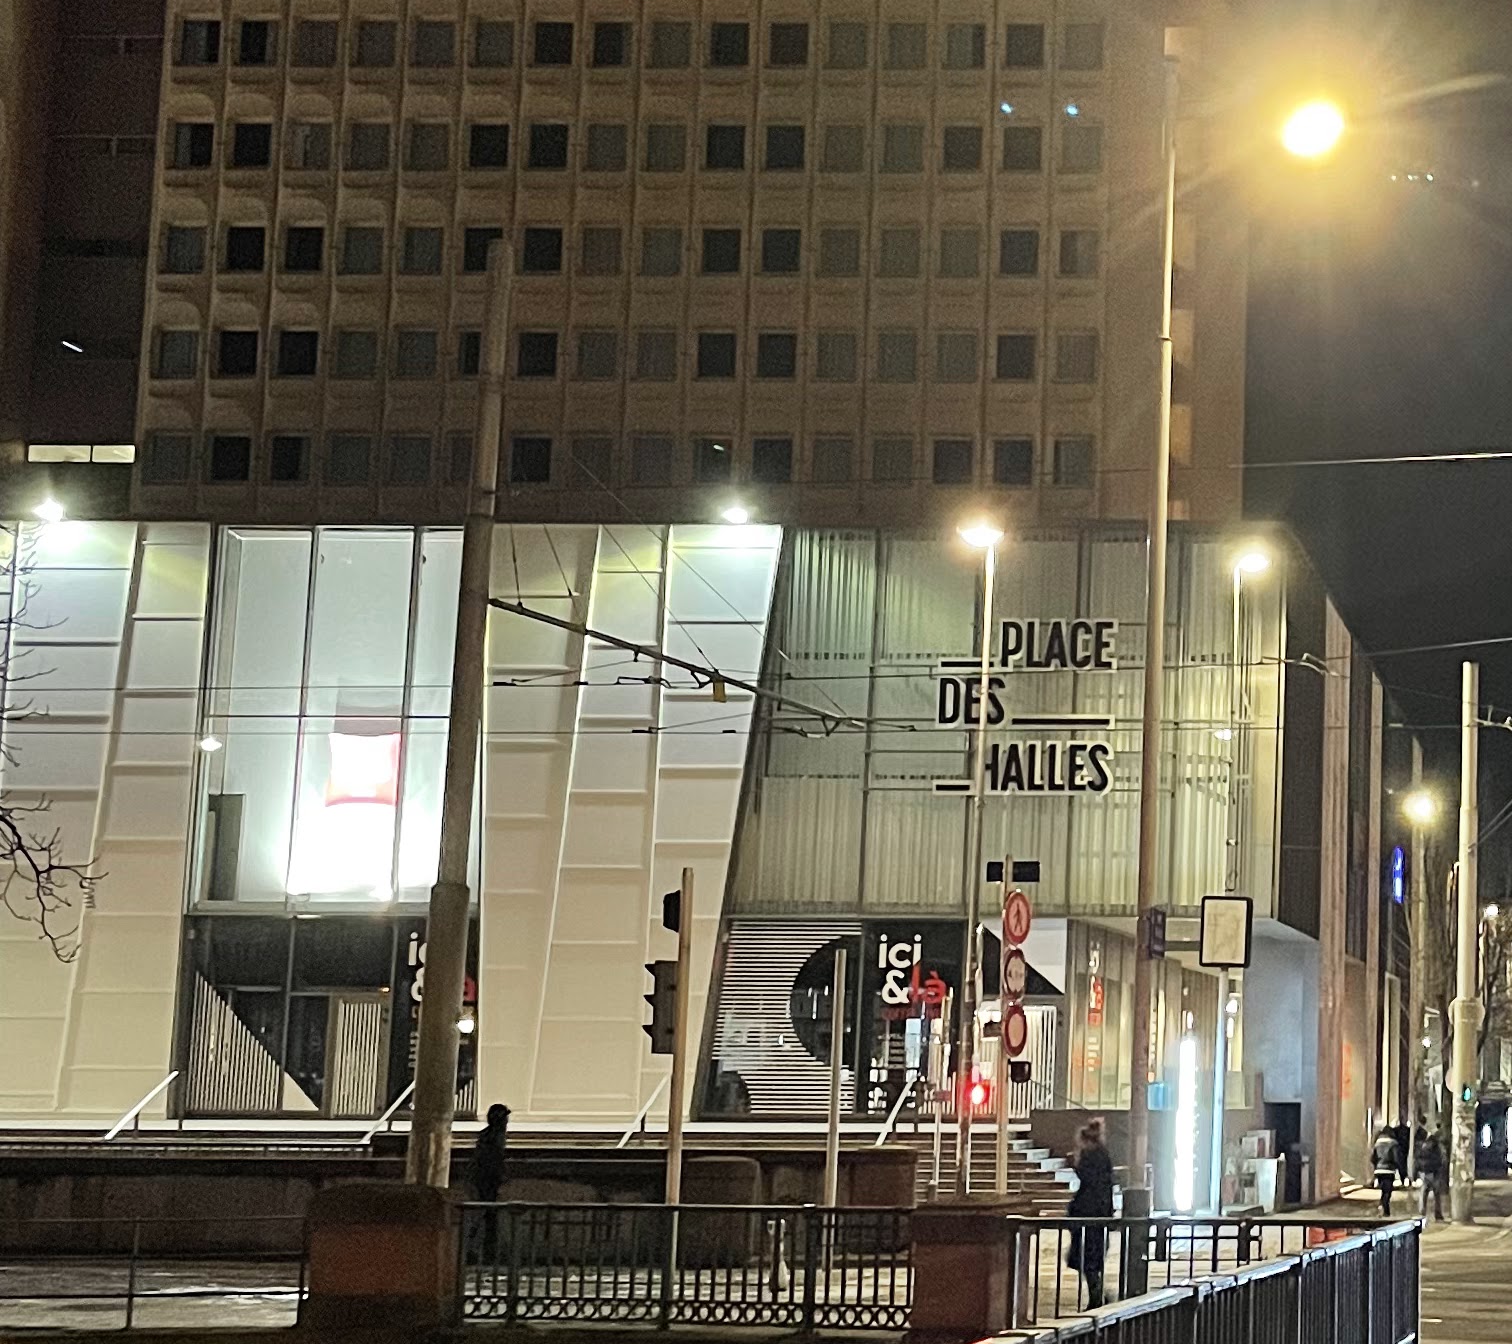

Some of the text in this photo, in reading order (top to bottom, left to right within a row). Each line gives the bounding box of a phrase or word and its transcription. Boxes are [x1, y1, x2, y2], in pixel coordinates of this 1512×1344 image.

[1001, 621, 1114, 668] PLACE
[939, 677, 1006, 725] DES
[984, 743, 1109, 792] HALLES
[879, 934, 922, 968] ici
